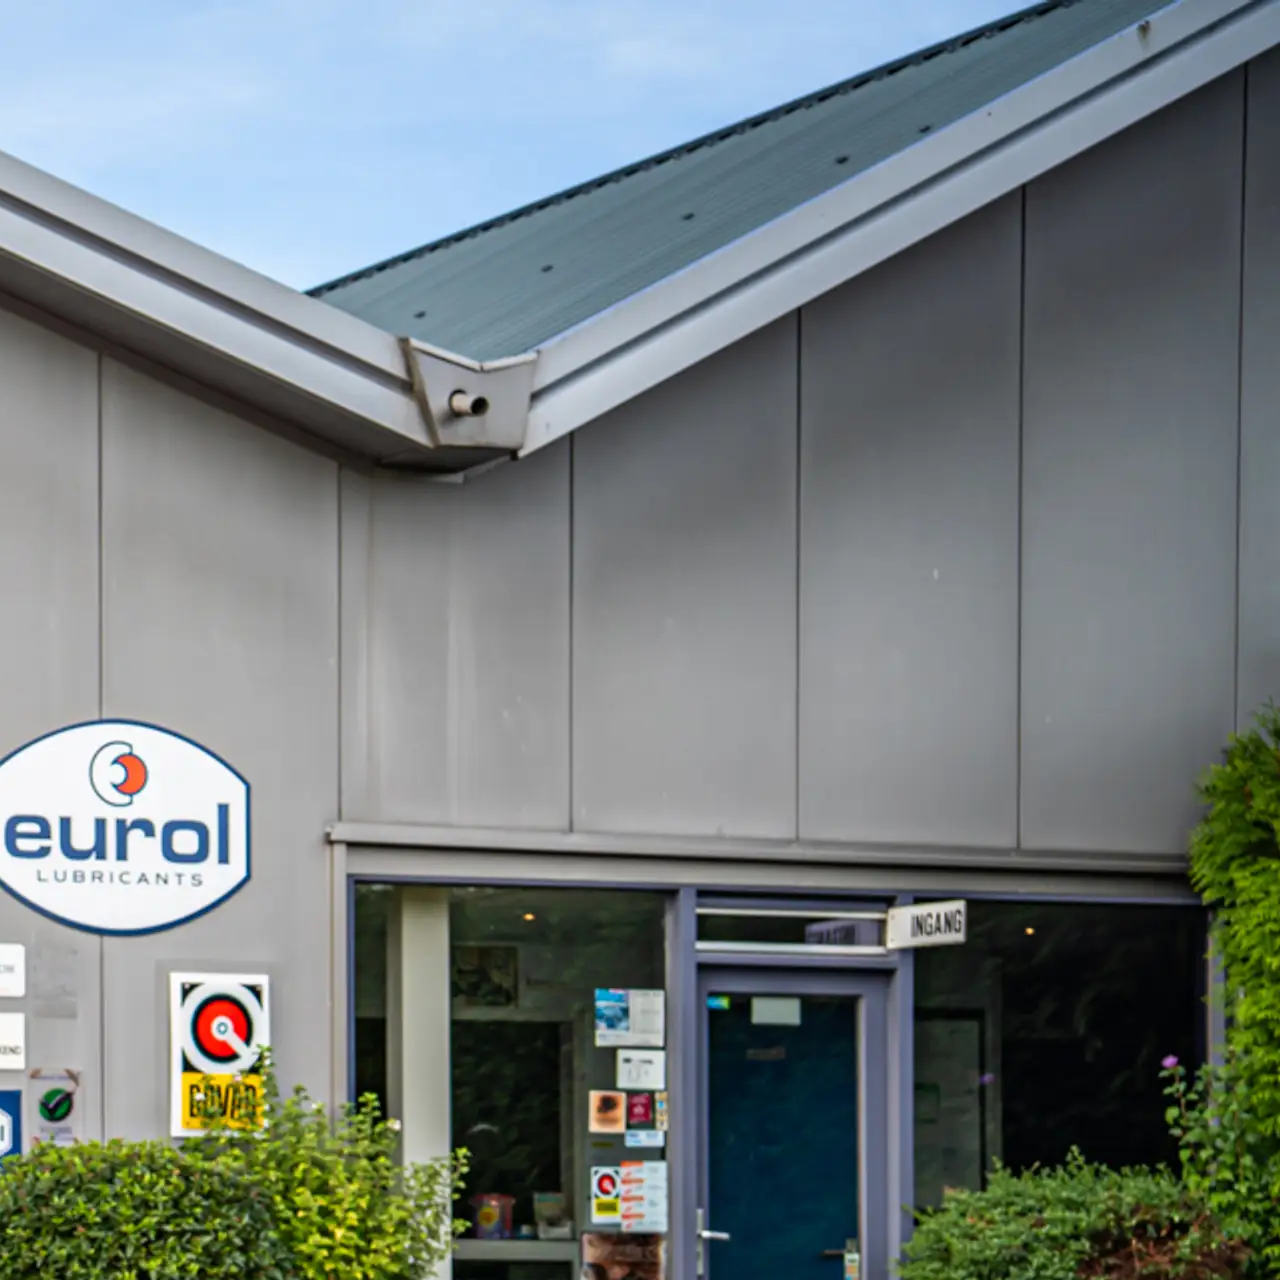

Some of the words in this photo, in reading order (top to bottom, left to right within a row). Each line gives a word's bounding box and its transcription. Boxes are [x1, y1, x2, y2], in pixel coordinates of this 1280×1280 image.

[3, 802, 229, 866] eurol
[37, 870, 204, 887] LUBRICANTS
[911, 909, 963, 937] INGANG
